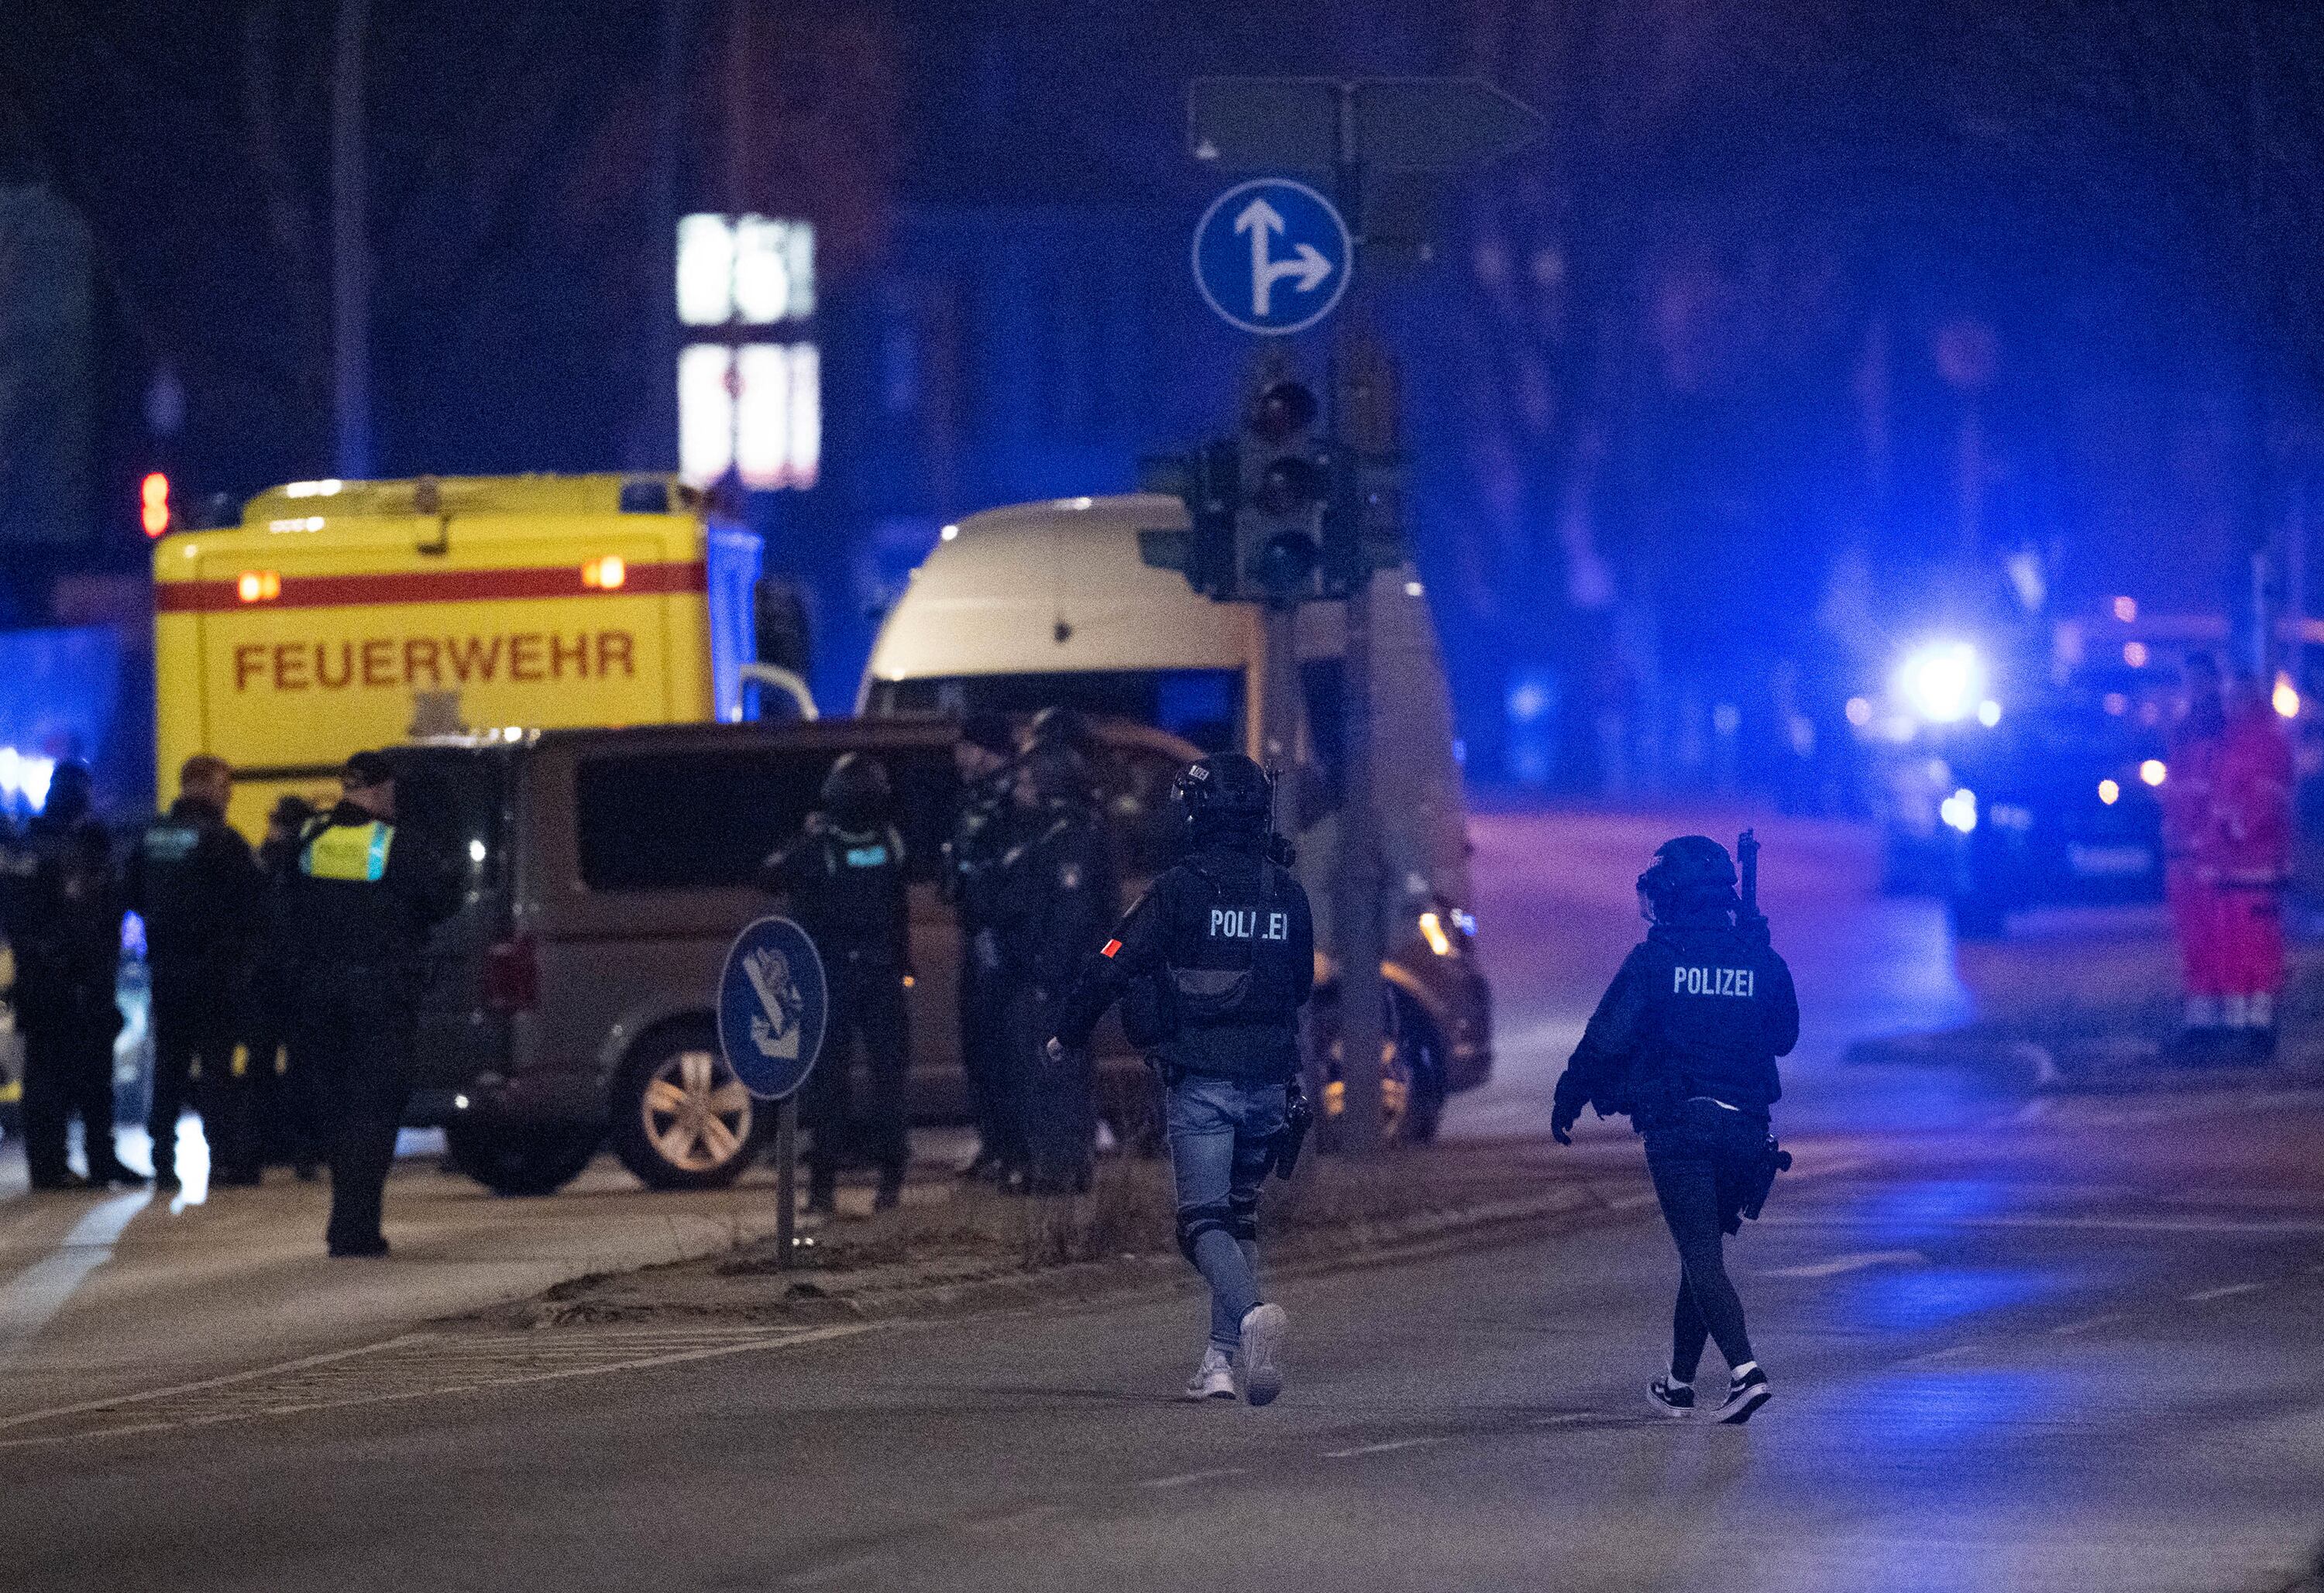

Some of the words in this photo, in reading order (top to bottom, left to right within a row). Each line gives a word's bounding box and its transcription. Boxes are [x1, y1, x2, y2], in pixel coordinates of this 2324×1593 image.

[233, 630, 635, 691] FEUERWEHR
[1210, 909, 1287, 940] POLIEI
[1674, 966, 1754, 997] POLIZEI
